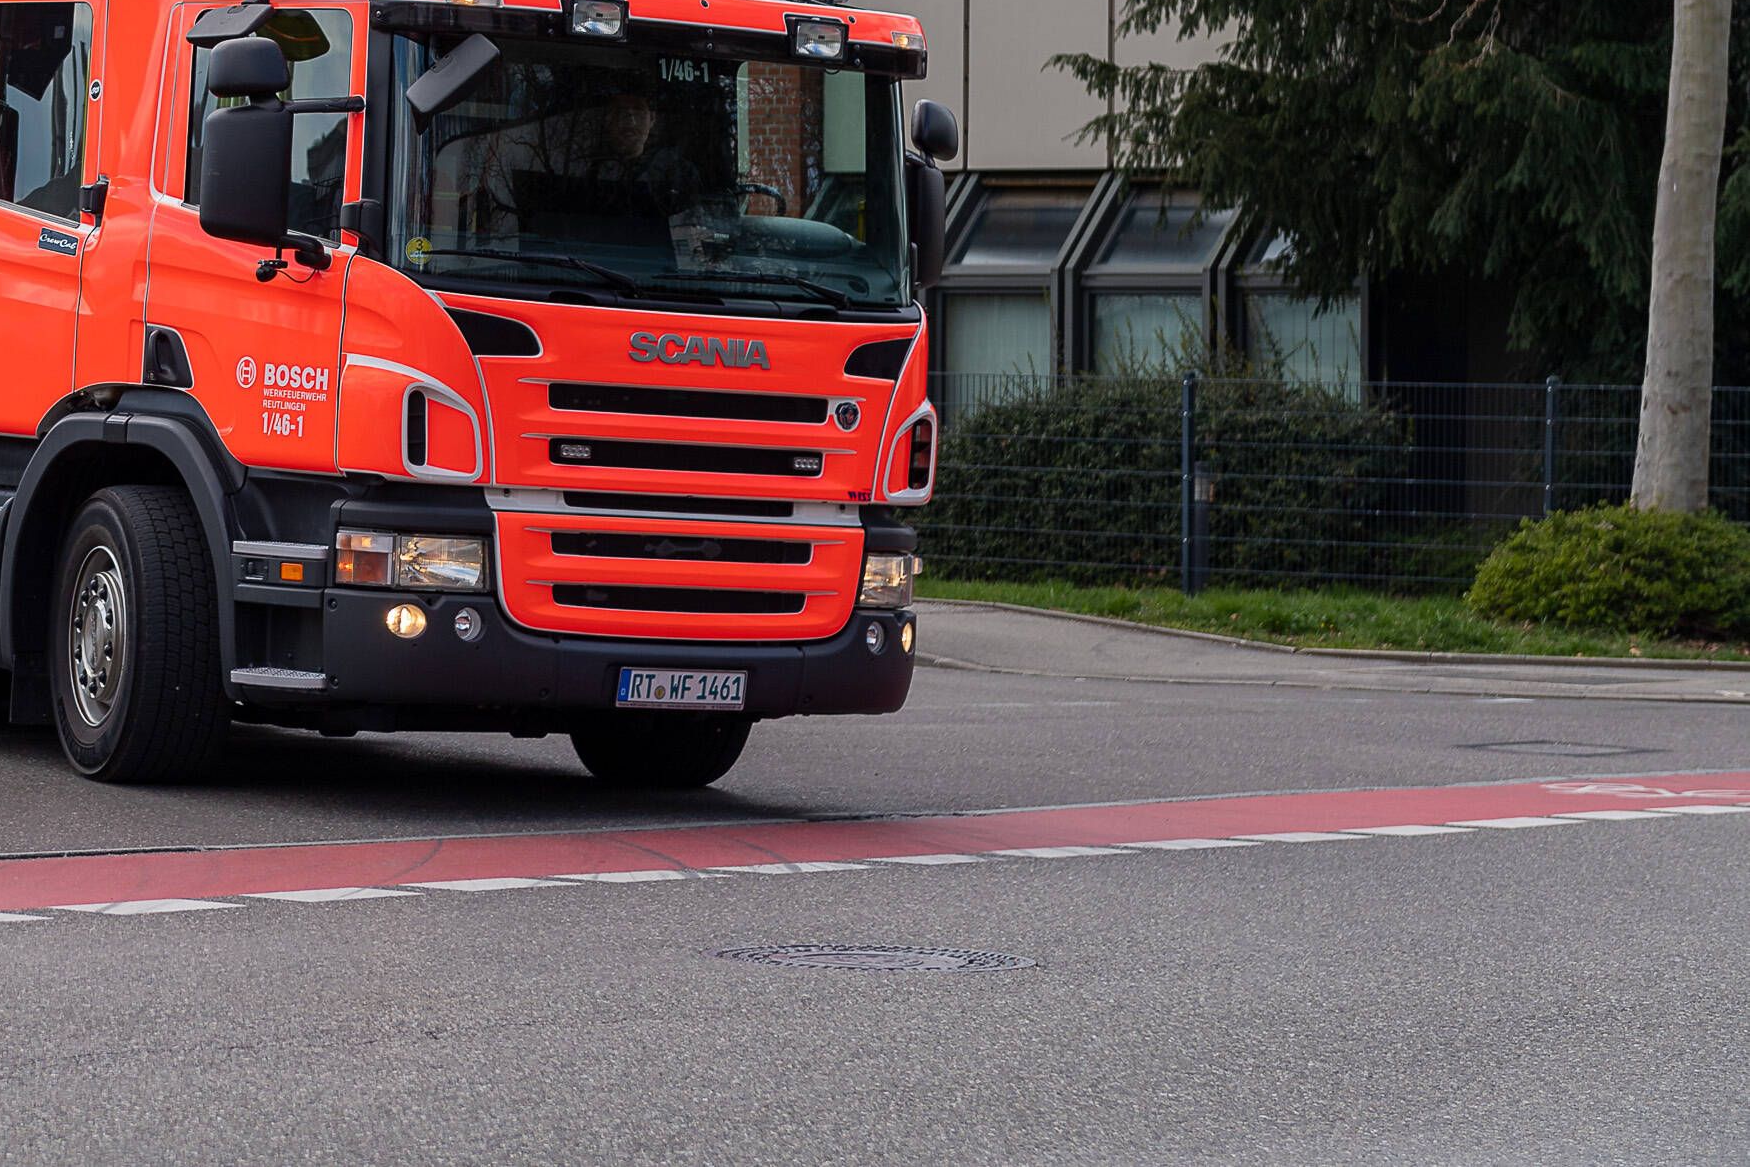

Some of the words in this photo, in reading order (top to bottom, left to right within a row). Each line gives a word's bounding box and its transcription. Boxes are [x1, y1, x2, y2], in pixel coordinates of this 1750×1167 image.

[659, 58, 709, 83] 1/46-1
[629, 331, 771, 370] SCANIA
[263, 363, 329, 390] BOSCH
[262, 399, 306, 411] REUTLINGEN
[263, 388, 327, 402] WERKFEUERWEHR
[262, 411, 304, 437] 1/46-1
[630, 673, 656, 699] RT
[669, 674, 693, 700] WF
[696, 675, 741, 701] 1461
